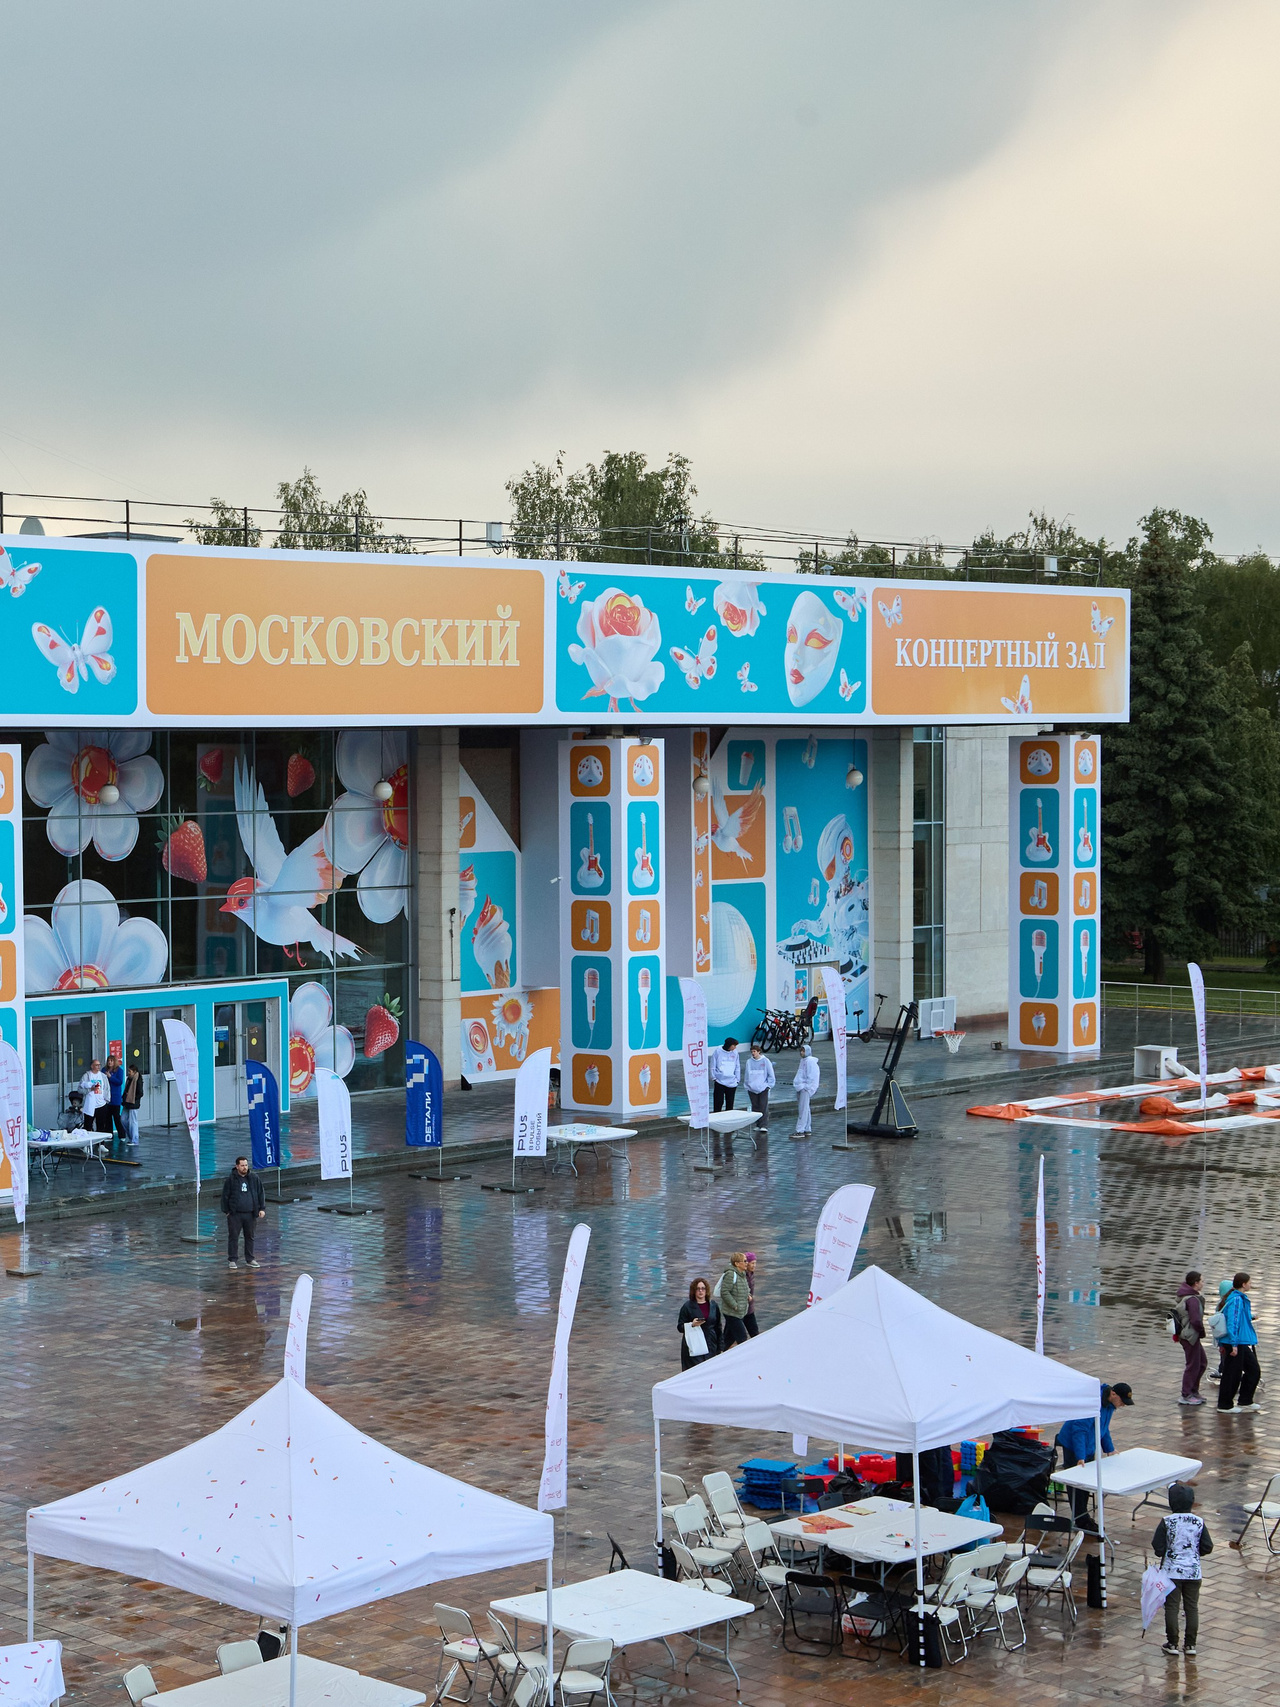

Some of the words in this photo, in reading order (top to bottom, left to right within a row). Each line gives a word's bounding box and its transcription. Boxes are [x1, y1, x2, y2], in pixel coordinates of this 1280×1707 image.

[175, 604, 520, 667] МОСКОВСКИЙ
[894, 631, 1060, 673] КОНЦЕРТНЫЙ
[1065, 641, 1106, 670] ЗАЛ
